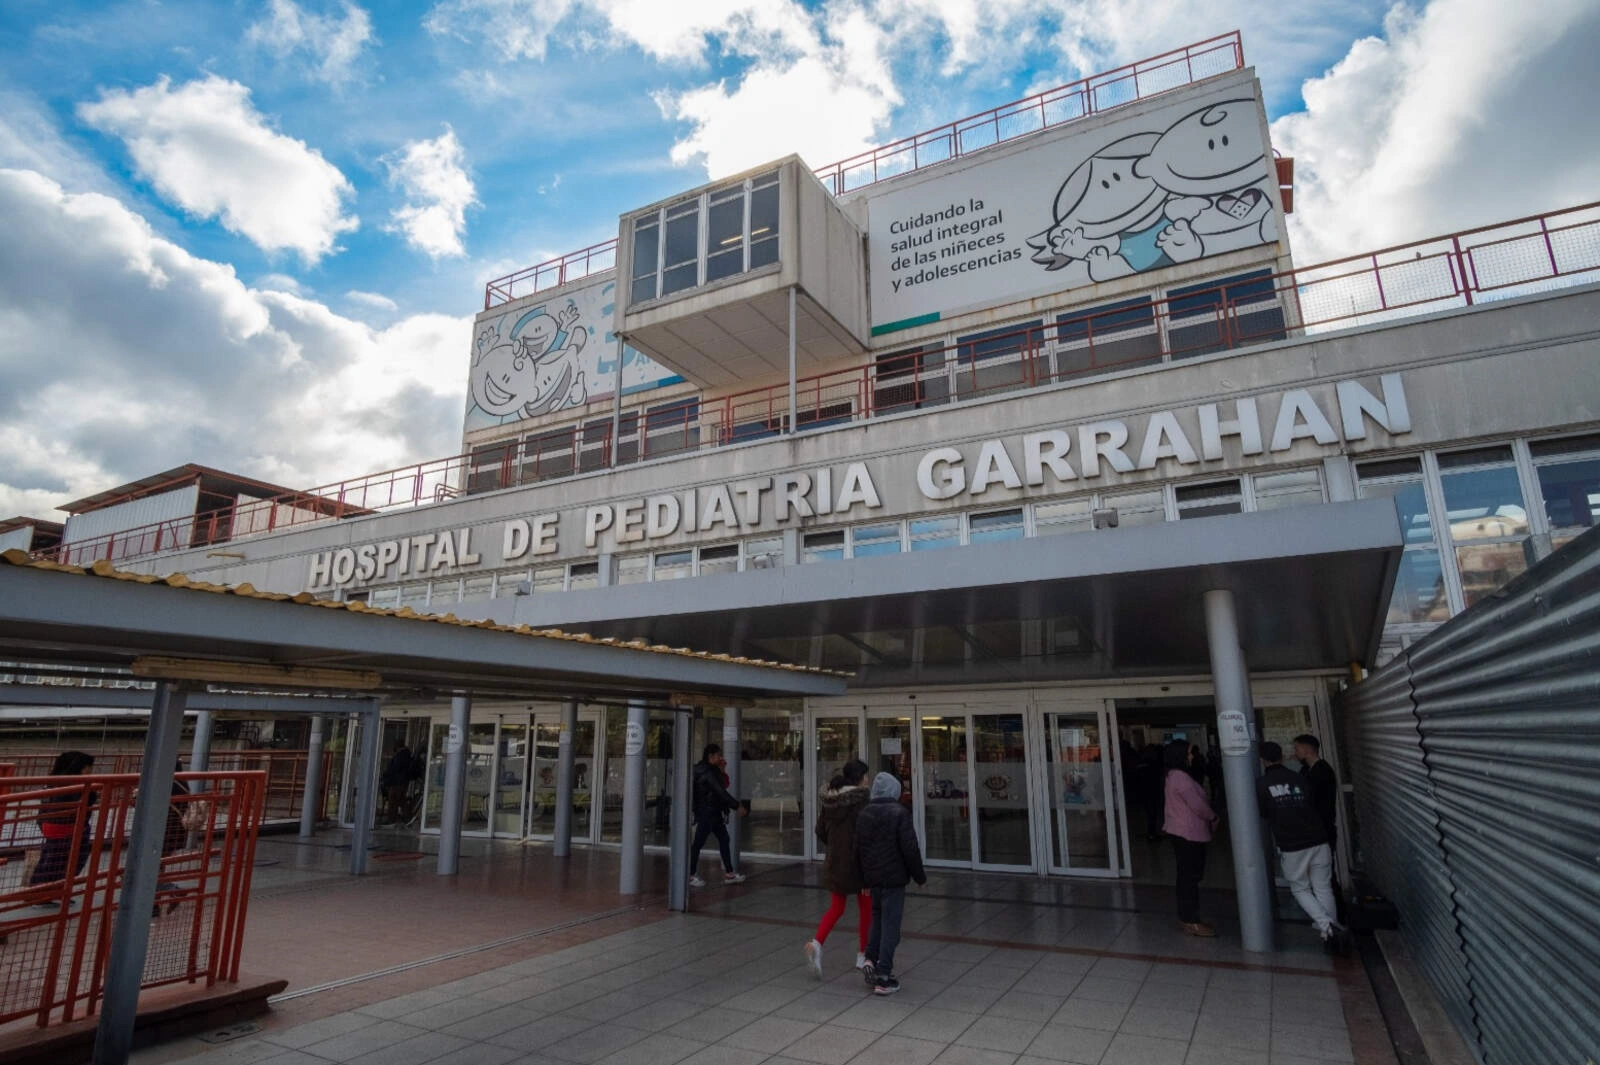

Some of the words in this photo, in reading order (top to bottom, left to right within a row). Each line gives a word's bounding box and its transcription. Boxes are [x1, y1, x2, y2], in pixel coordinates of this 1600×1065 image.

[890, 203, 965, 235] Cuidando
[970, 198, 984, 212] la
[891, 232, 933, 253] salud
[937, 209, 1003, 241] integral
[891, 255, 911, 271] de
[914, 251, 937, 265] las
[941, 232, 1006, 259] niñeces
[891, 279, 902, 293] y
[904, 247, 1022, 288] adolescencias
[308, 527, 481, 588] HOSPITAL
[503, 512, 560, 561] DE
[585, 461, 882, 548] PEDIATRIA
[916, 372, 1413, 500] GARRAHAN
